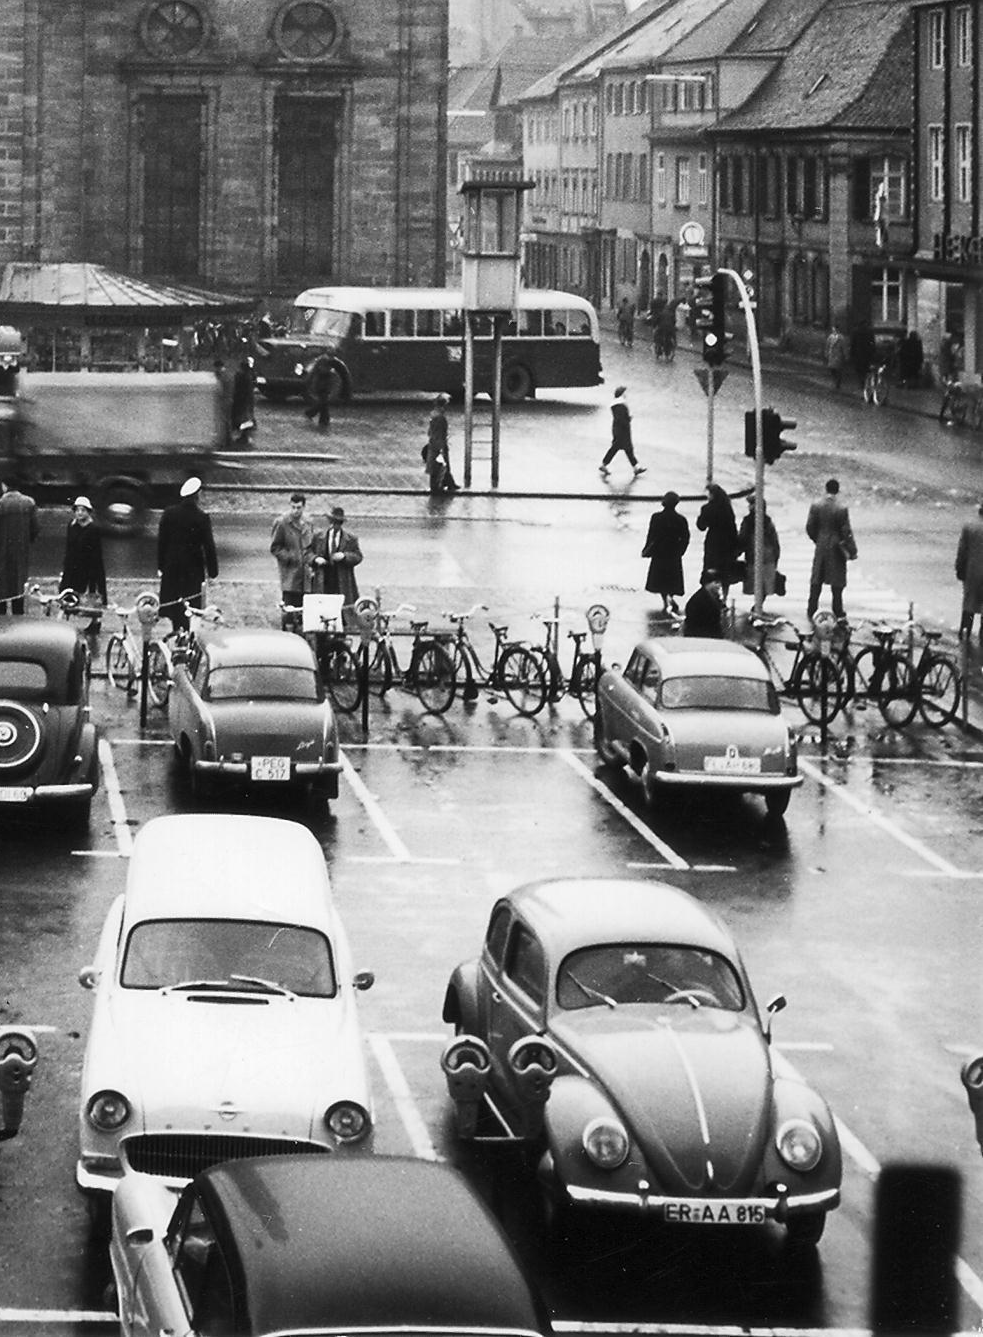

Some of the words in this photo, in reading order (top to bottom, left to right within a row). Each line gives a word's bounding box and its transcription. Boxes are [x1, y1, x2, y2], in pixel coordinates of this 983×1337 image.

[262, 758, 286, 768] PEG
[255, 769, 263, 778] C
[267, 769, 287, 778] 517
[736, 1206, 764, 1222] 815
